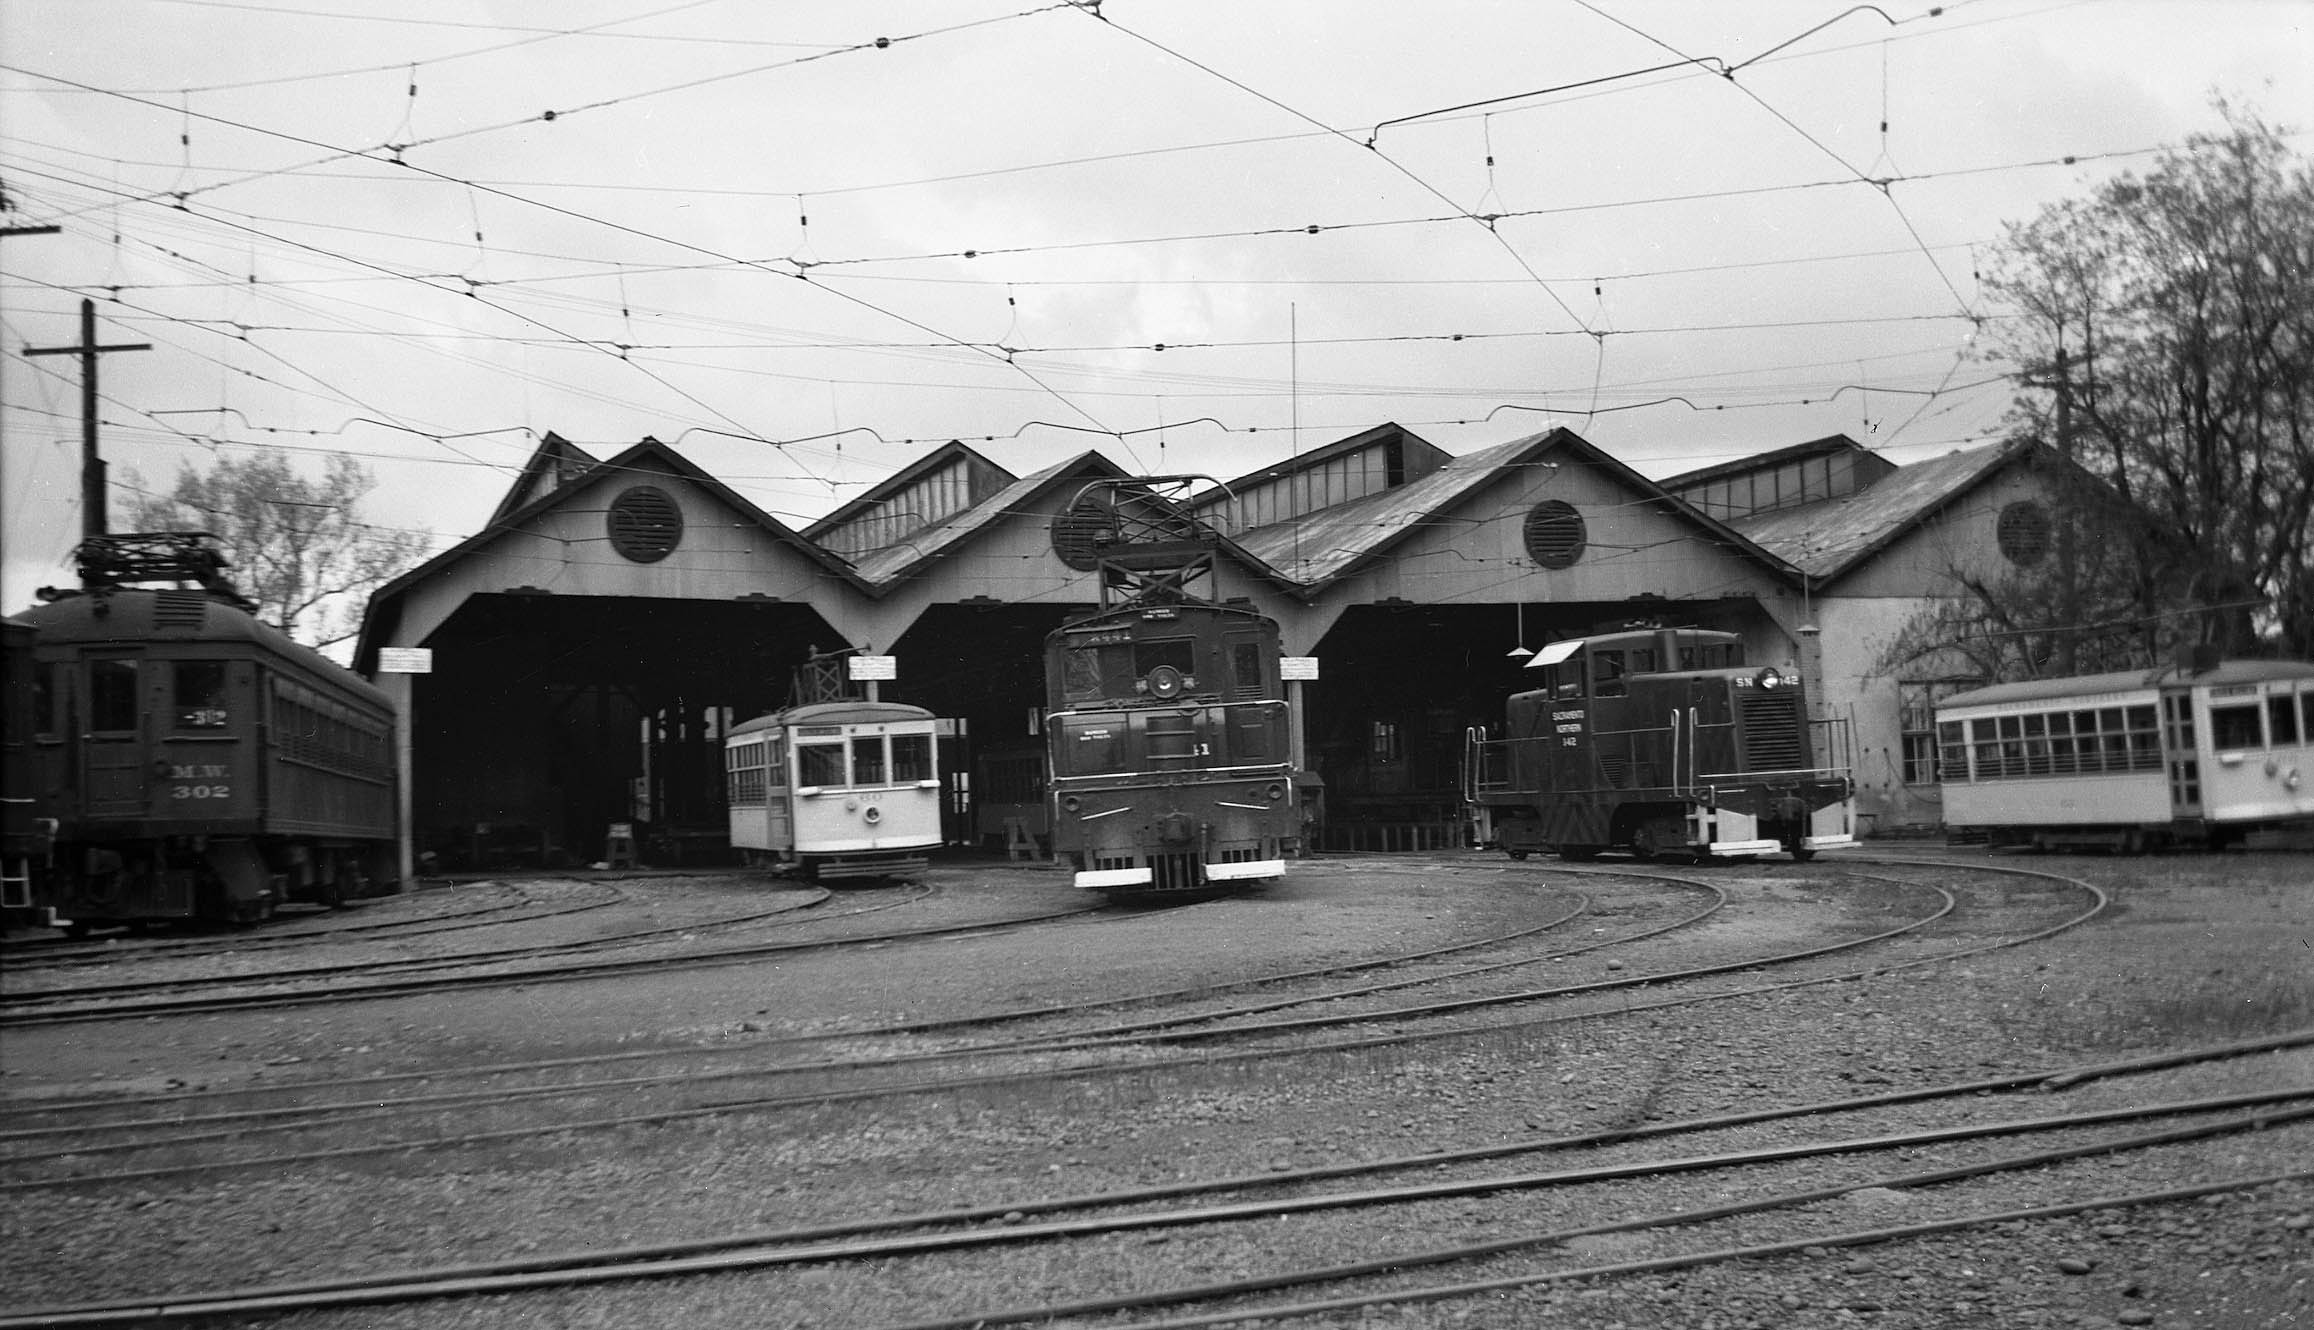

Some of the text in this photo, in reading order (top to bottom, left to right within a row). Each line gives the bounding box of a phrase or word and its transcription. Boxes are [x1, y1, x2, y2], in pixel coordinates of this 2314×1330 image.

[1735, 675, 1799, 687] SN 142
[1562, 736, 1577, 747] 142
[170, 785, 231, 799] 302
